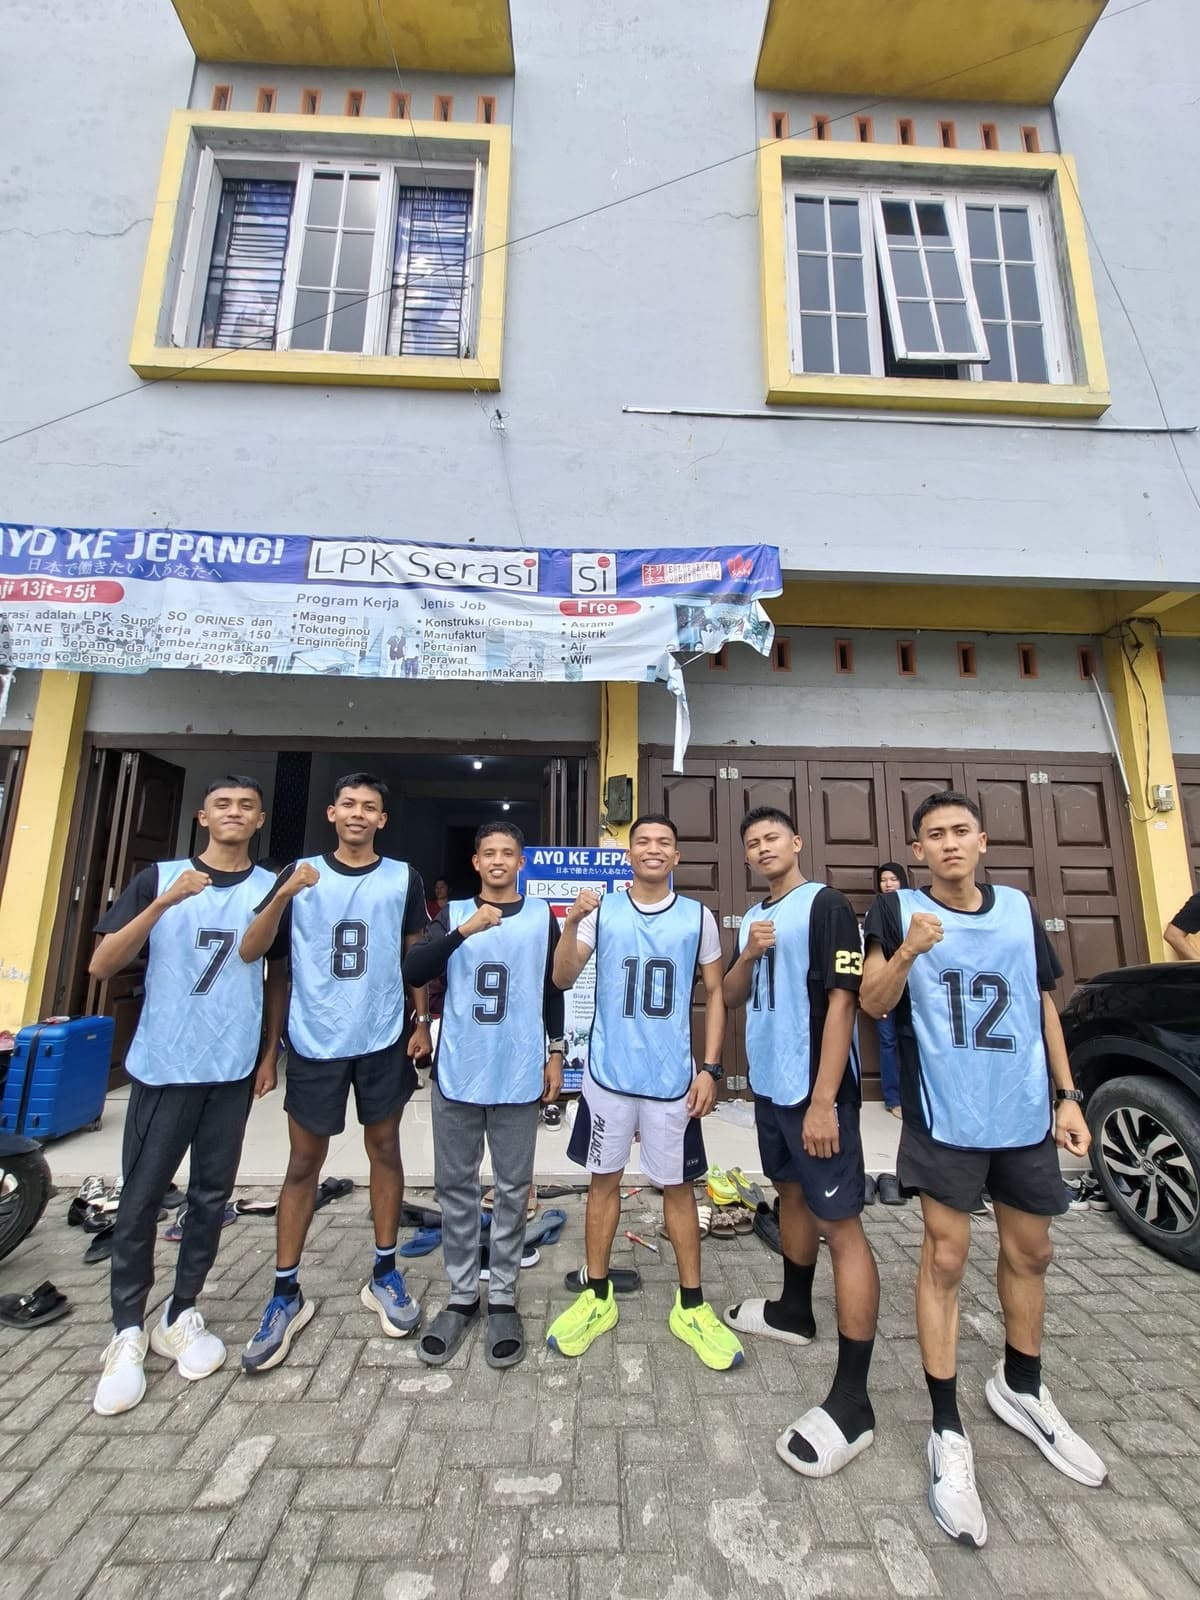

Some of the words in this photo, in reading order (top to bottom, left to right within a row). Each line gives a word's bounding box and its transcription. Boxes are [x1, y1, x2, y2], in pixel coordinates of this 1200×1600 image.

[0, 528, 57, 557] YO
[67, 530, 117, 560] KE
[125, 532, 285, 565] JEPANG!
[314, 547, 394, 577] LPK
[407, 550, 537, 587] Serasi
[578, 555, 611, 593] Si
[21, 581, 96, 601] 13jt-15jt
[296, 593, 358, 608] Program
[363, 596, 400, 611] Kerja
[420, 597, 455, 611] Jenis
[460, 599, 486, 611] Job
[577, 600, 617, 615] Free
[0, 610, 29, 620] erasi
[36, 610, 76, 620] adalah
[84, 611, 113, 621] LPK
[120, 614, 153, 628] Supp
[168, 611, 187, 621] SO
[195, 615, 245, 626] ORINES
[251, 618, 273, 627] dan
[300, 611, 346, 624] Magang
[425, 617, 484, 628] Konstruksi
[488, 617, 533, 628] (Genba)
[570, 620, 614, 628] Asrama
[158, 624, 191, 636] kerja
[202, 630, 238, 639] sama
[249, 630, 271, 640] 150
[298, 623, 370, 637] Tokuteginou
[423, 629, 486, 640] Manufaktur
[570, 629, 606, 639] Listrik
[41, 637, 53, 647] di
[63, 639, 115, 653] Jepang
[297, 637, 368, 649] Enginnering
[423, 641, 477, 653] Pertanian
[570, 641, 587, 652] Air
[10, 652, 50, 663] agang
[55, 650, 70, 661] ke
[74, 650, 126, 667] Jepang
[175, 651, 200, 661] dari
[203, 653, 267, 665] 2018-2026
[422, 654, 468, 665] Perawat
[570, 654, 592, 665] Wifi
[533, 850, 564, 865] AYO
[568, 851, 589, 865] KE
[593, 852, 631, 866] JEPA
[528, 882, 556, 896] LPK
[331, 919, 369, 981] 8
[190, 928, 238, 996] 7
[835, 950, 863, 976] 23
[472, 961, 510, 1025] 9
[622, 956, 677, 1020] 10
[939, 969, 1017, 1053] 12
